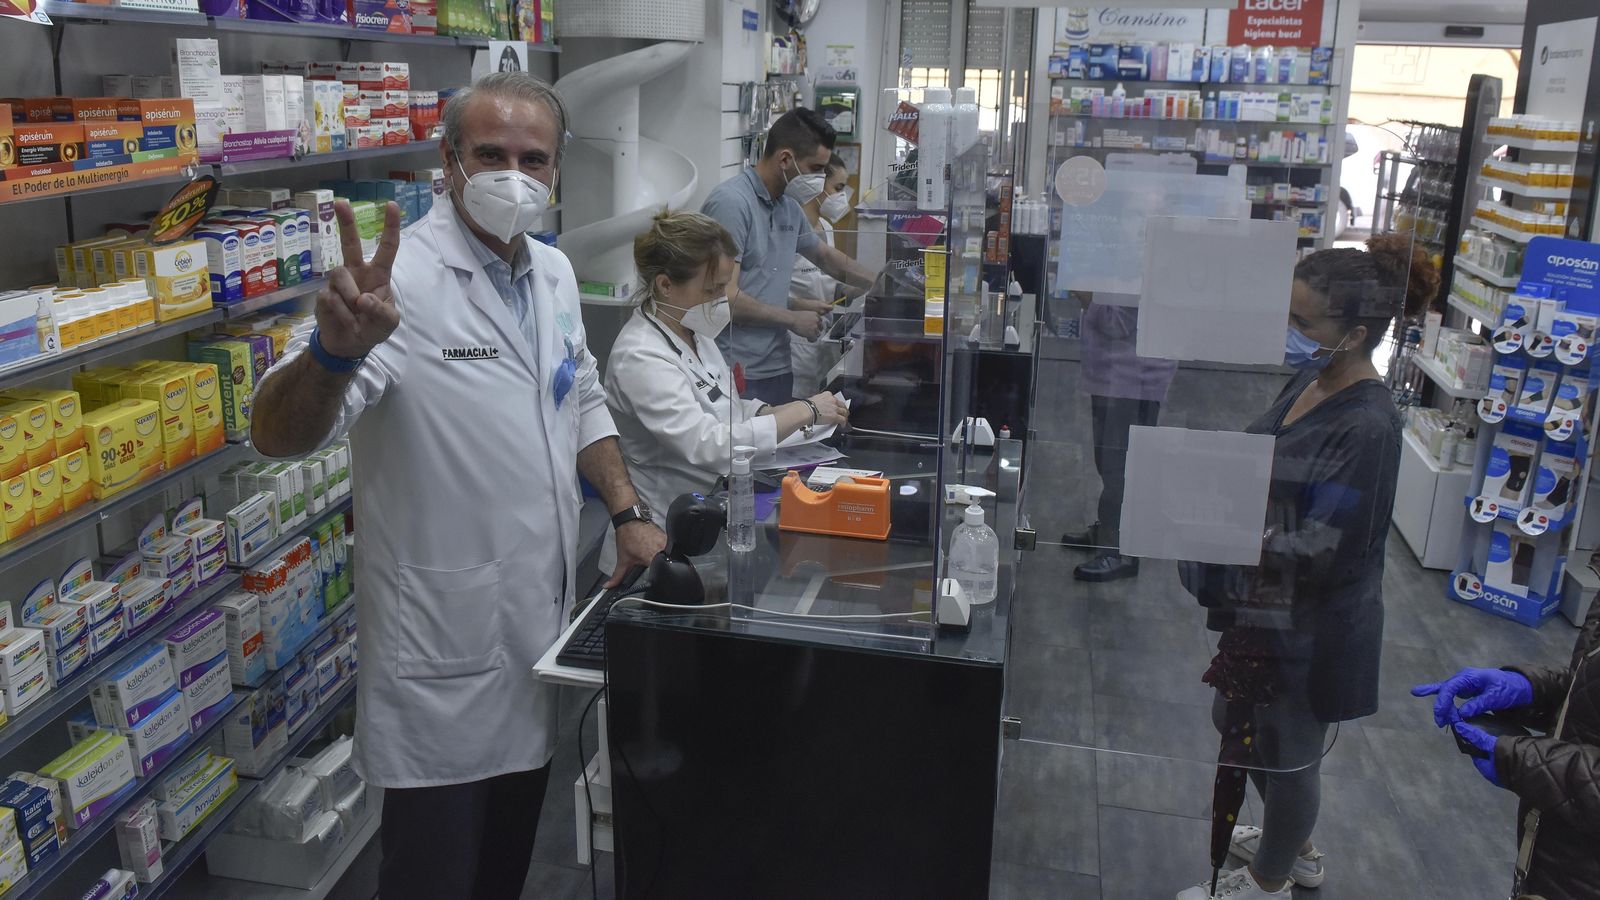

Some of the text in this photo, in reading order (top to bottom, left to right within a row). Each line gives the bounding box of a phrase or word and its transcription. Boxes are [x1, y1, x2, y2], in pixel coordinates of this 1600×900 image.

[355, 12, 390, 25] fisiocrem
[1247, 15, 1304, 27] Especialistas
[1244, 28, 1302, 40] higiene bucal
[887, 111, 919, 123] HALLS
[887, 161, 918, 172] Trident
[12, 169, 130, 196] El Poder de la Multienergía
[1547, 255, 1599, 271] aposán
[441, 348, 487, 359] FARMACIA
[221, 374, 237, 432] prevent
[101, 447, 117, 464] 90
[1480, 590, 1519, 610] osán
[126, 667, 157, 691] kaleidon
[142, 714, 173, 739] kaleidon
[76, 757, 115, 788] kaleidon
